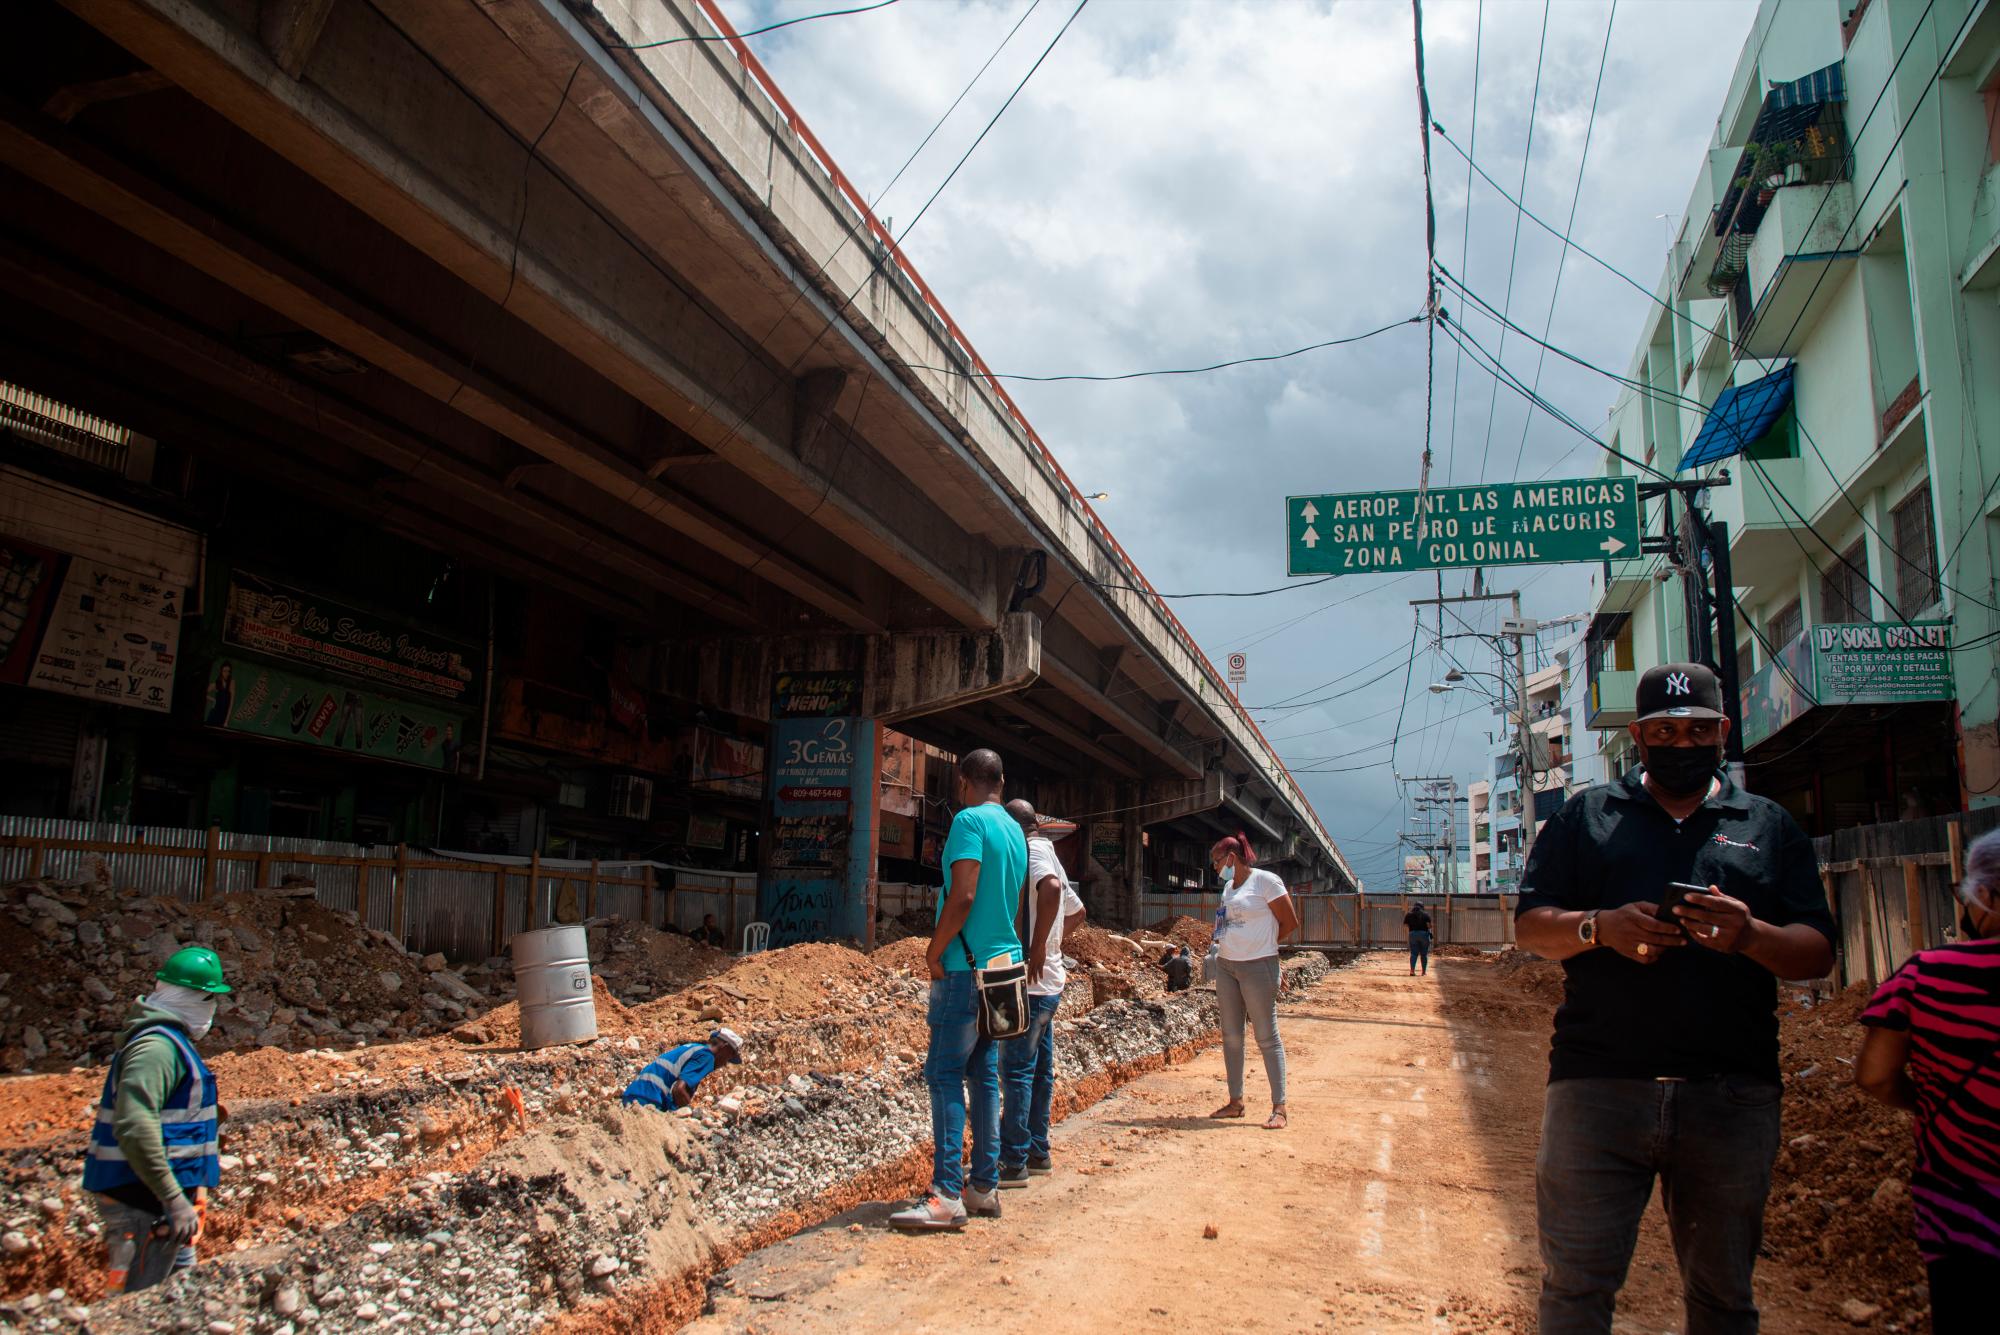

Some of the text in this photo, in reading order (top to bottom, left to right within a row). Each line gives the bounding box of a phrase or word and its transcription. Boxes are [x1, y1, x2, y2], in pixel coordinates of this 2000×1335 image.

[1333, 498, 1400, 519] AEROP.
[1458, 490, 1499, 511] LAS
[1512, 483, 1625, 508] AMERICAS
[1333, 522, 1375, 543] SAN
[1472, 517, 1496, 535] DE
[1344, 540, 1540, 567] ZONA COLONIAL
[245, 621, 313, 649] IMPORTADORES
[271, 595, 300, 626] De
[303, 607, 329, 634] los
[332, 617, 391, 652] Santos
[1841, 627, 1882, 650] SOSA
[1885, 625, 1946, 649] OUTLET
[1826, 652, 1945, 662] VENTAS DE ROPAS DE PACAS
[1832, 663, 1941, 673] AL POR MAYOR Y DETALLE
